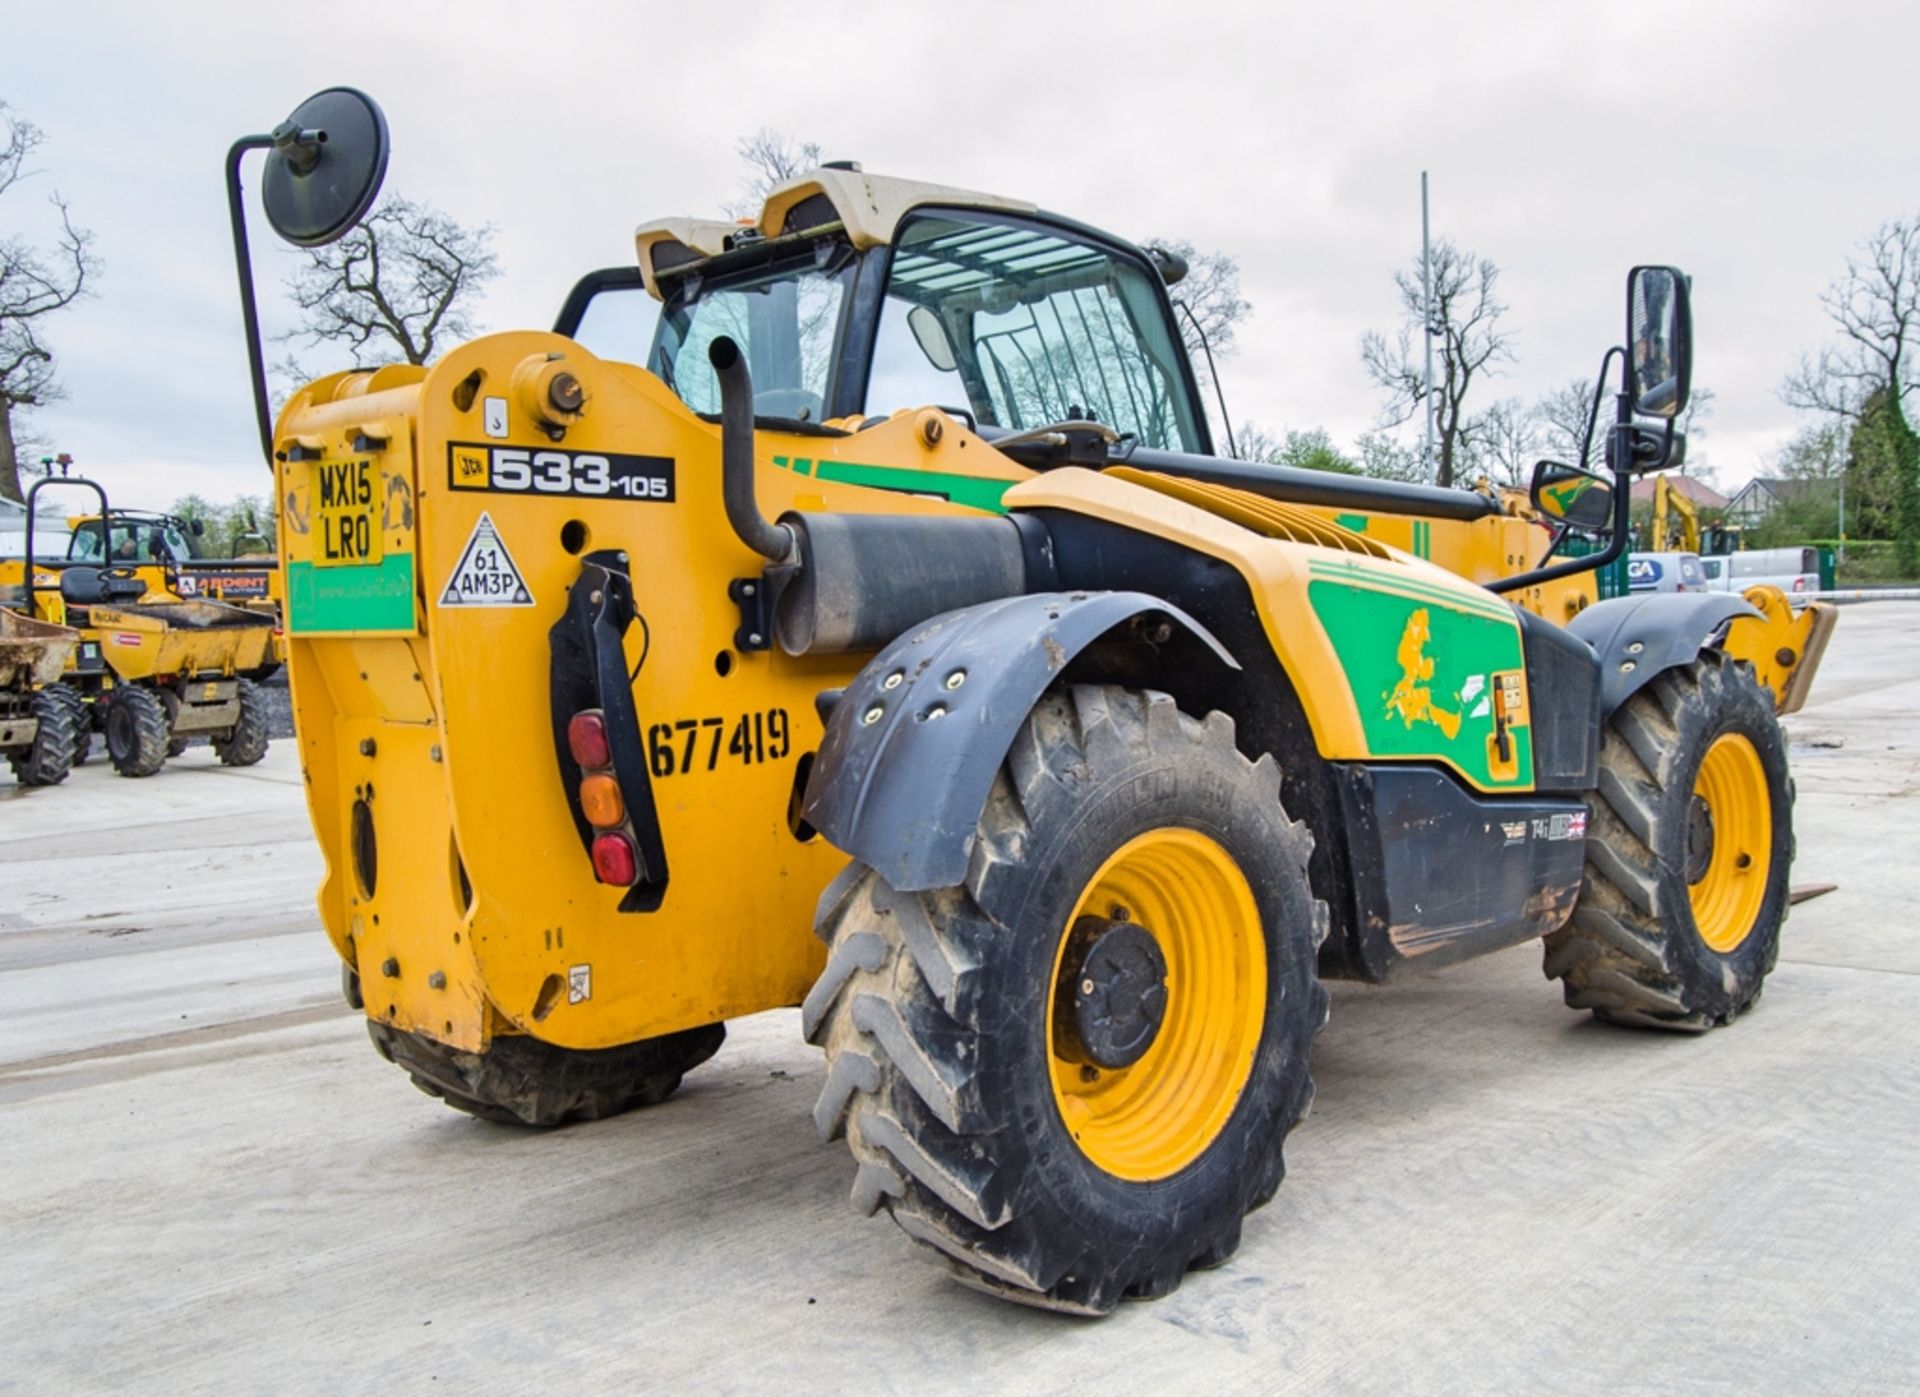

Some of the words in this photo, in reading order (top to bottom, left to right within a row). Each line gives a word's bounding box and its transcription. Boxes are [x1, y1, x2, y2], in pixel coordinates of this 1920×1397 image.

[320, 461, 371, 508] MX15
[325, 514, 370, 559] LRO
[475, 549, 499, 571] 61
[198, 577, 266, 589] ARDENT
[461, 573, 514, 595] AM3P
[648, 707, 790, 778] 677419
